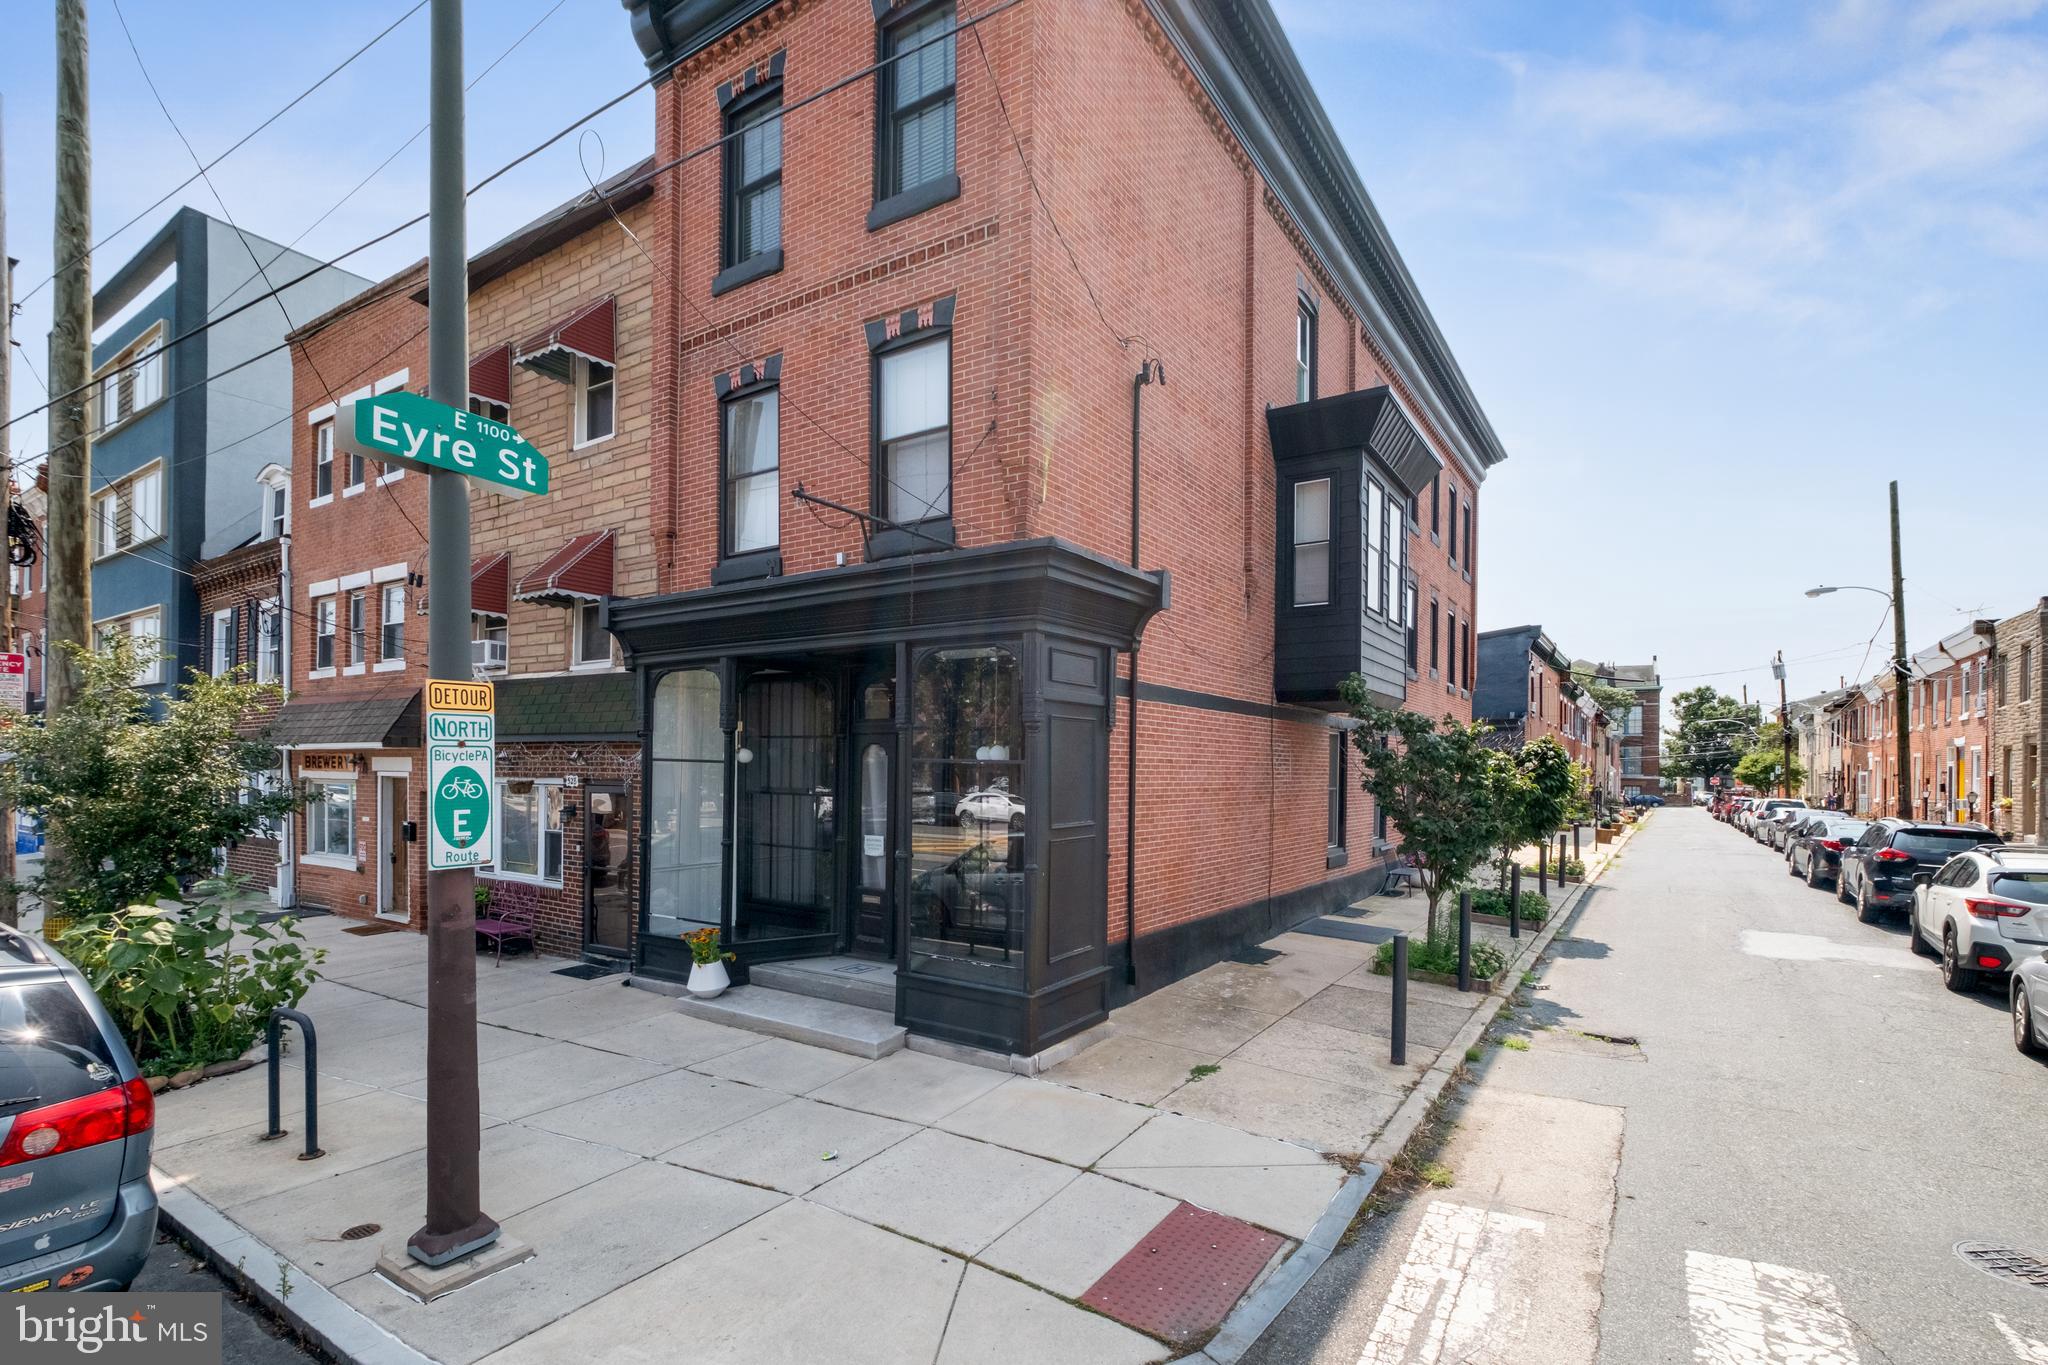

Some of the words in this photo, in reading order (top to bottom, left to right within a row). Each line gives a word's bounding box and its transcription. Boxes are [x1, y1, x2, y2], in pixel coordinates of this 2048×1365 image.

[454, 410, 467, 431] E
[477, 420, 510, 442] 1100
[373, 405, 477, 468] Eyre
[498, 448, 536, 487] St
[434, 687, 487, 707] DETOUR
[434, 717, 488, 738] NORTH
[434, 749, 488, 764] BicyclePA
[453, 809, 472, 837] E
[445, 851, 479, 863] Route
[0, 1207, 72, 1233] SIENNA
